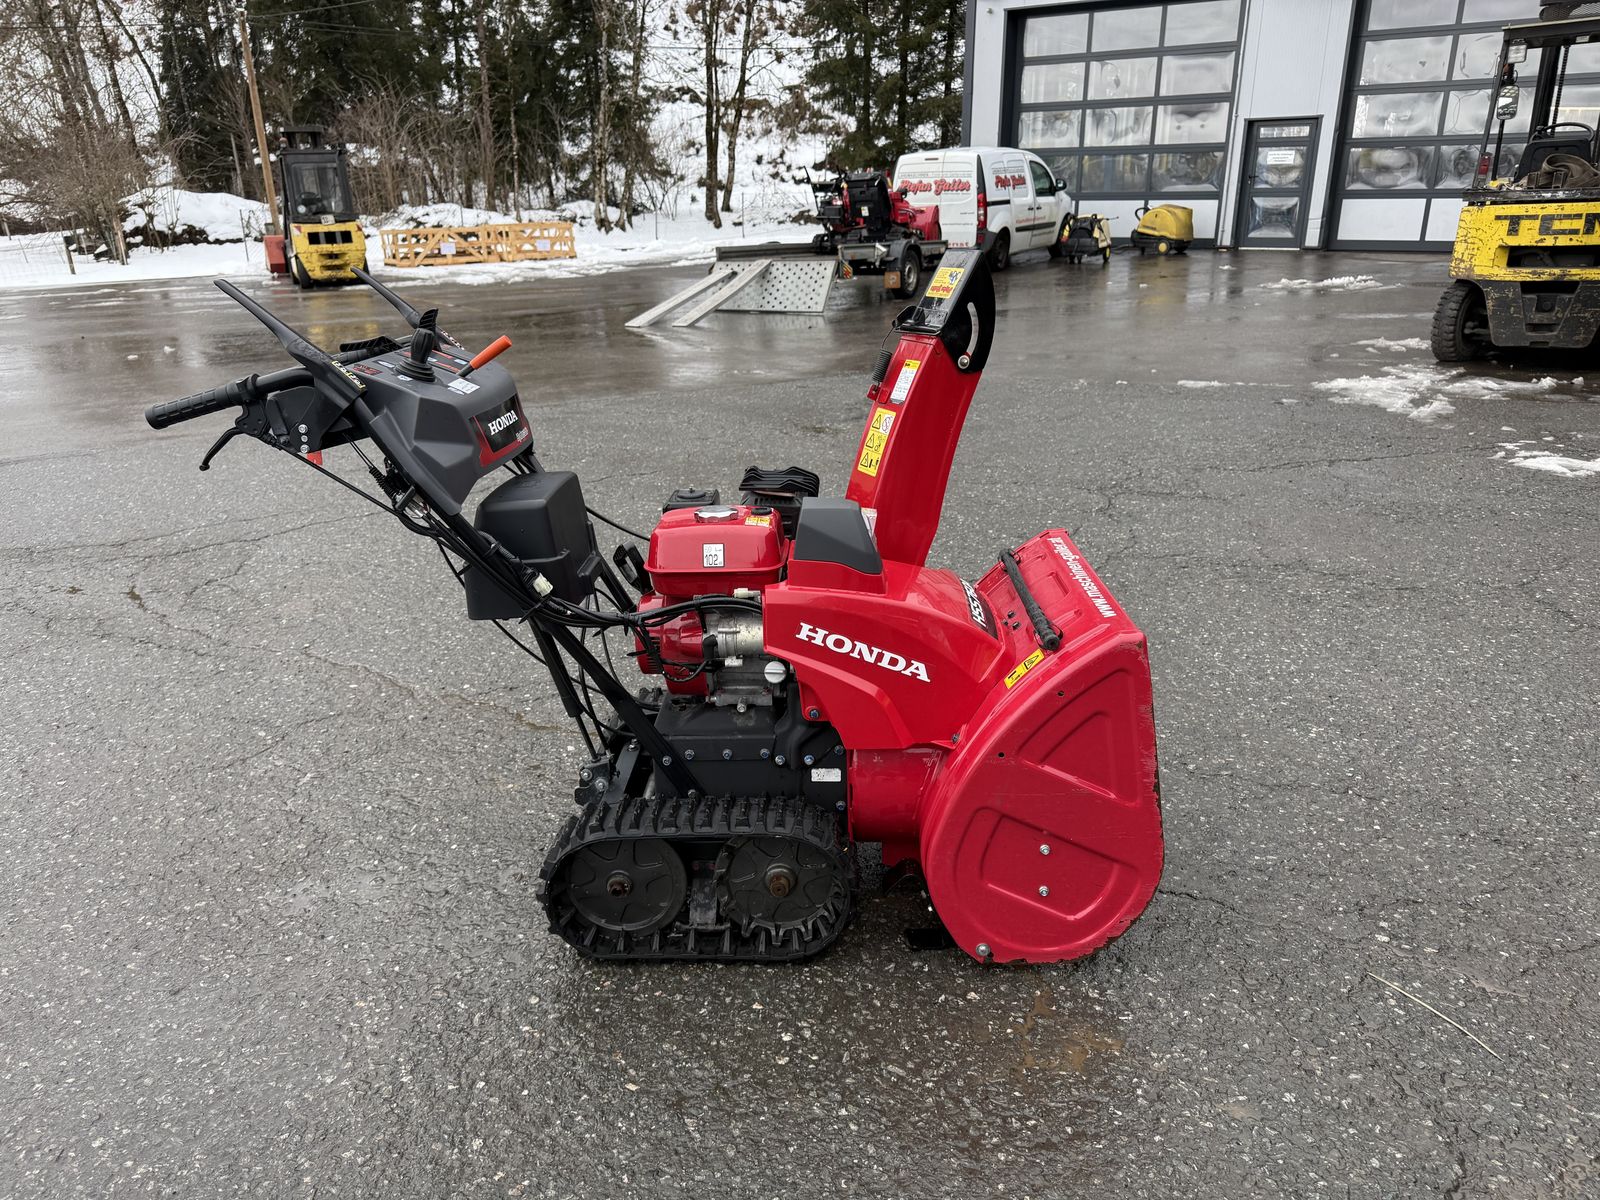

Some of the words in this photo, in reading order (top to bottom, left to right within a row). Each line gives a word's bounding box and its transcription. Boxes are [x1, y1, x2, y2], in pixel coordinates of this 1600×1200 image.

[488, 410, 518, 435] HONDA
[704, 553, 719, 566] 102
[795, 622, 931, 683] HONDA
